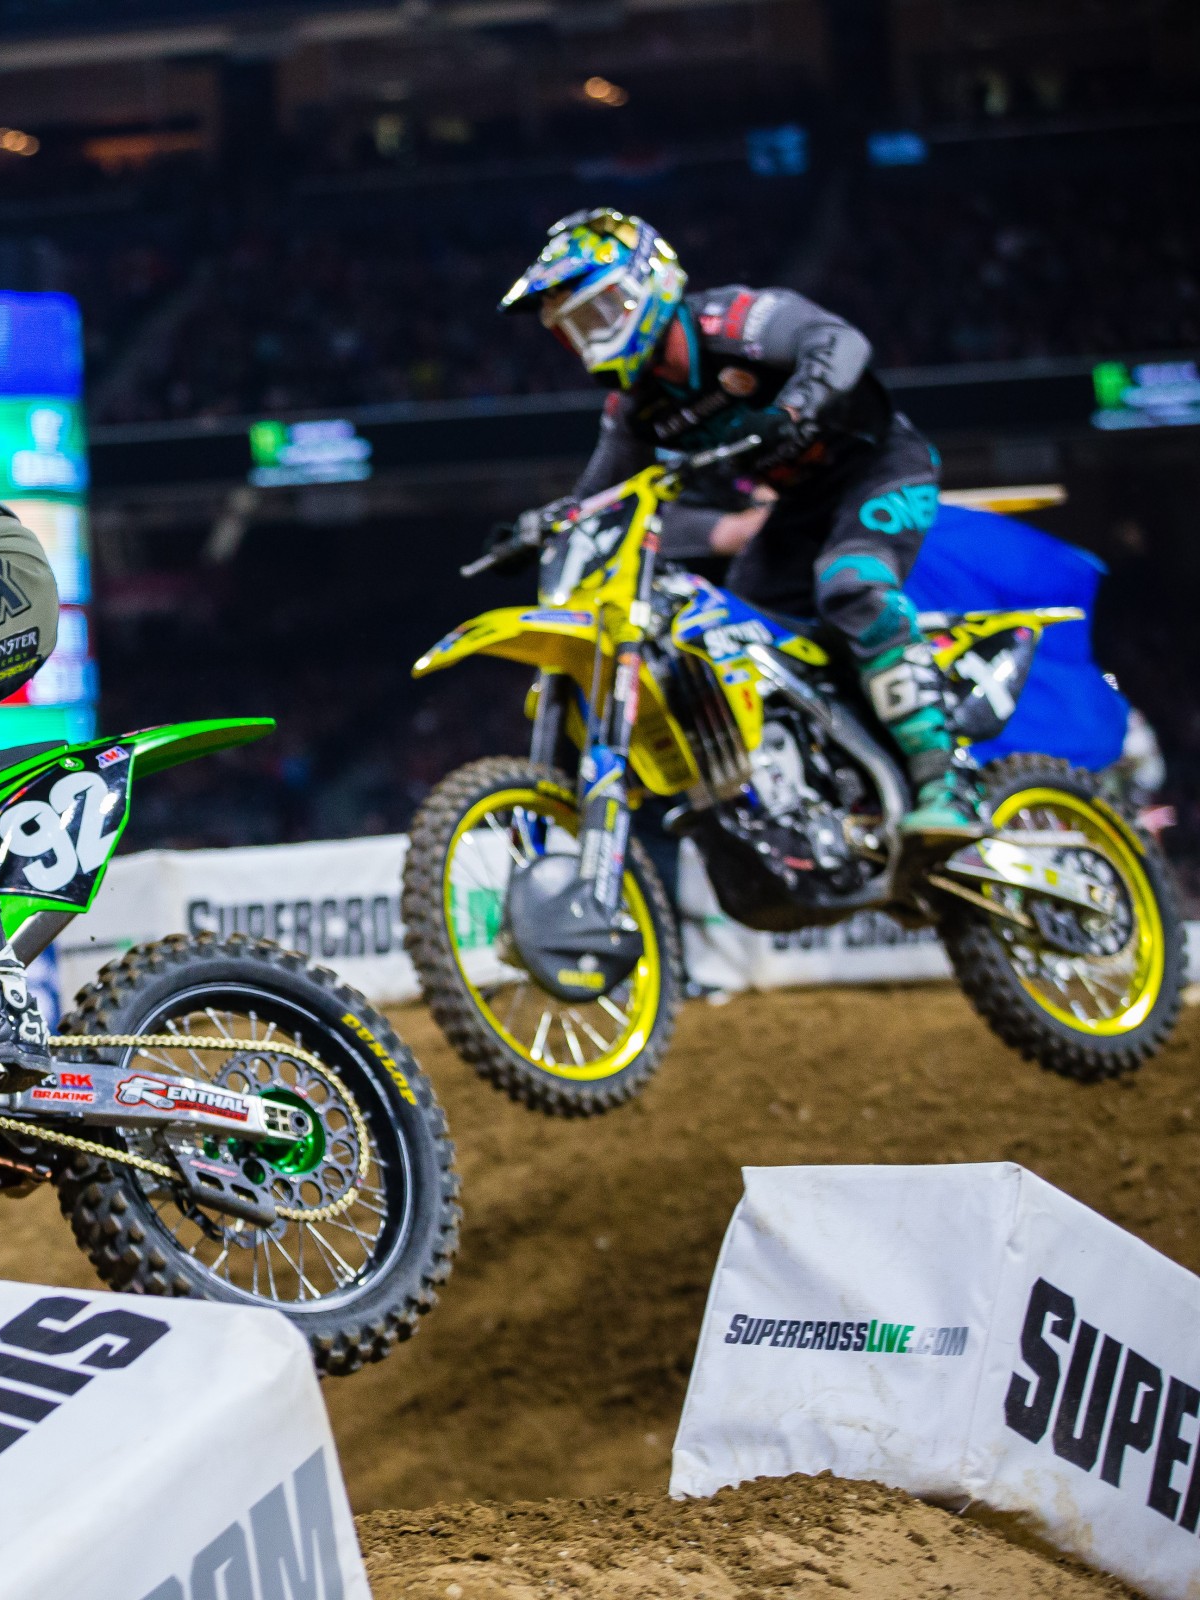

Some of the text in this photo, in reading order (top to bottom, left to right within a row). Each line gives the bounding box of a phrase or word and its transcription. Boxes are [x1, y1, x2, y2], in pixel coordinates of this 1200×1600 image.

[188, 897, 403, 957] SUPERCRO
[341, 1013, 417, 1106] DUNLOP
[32, 1089, 94, 1103] BRAKING
[60, 1073, 93, 1089] RK
